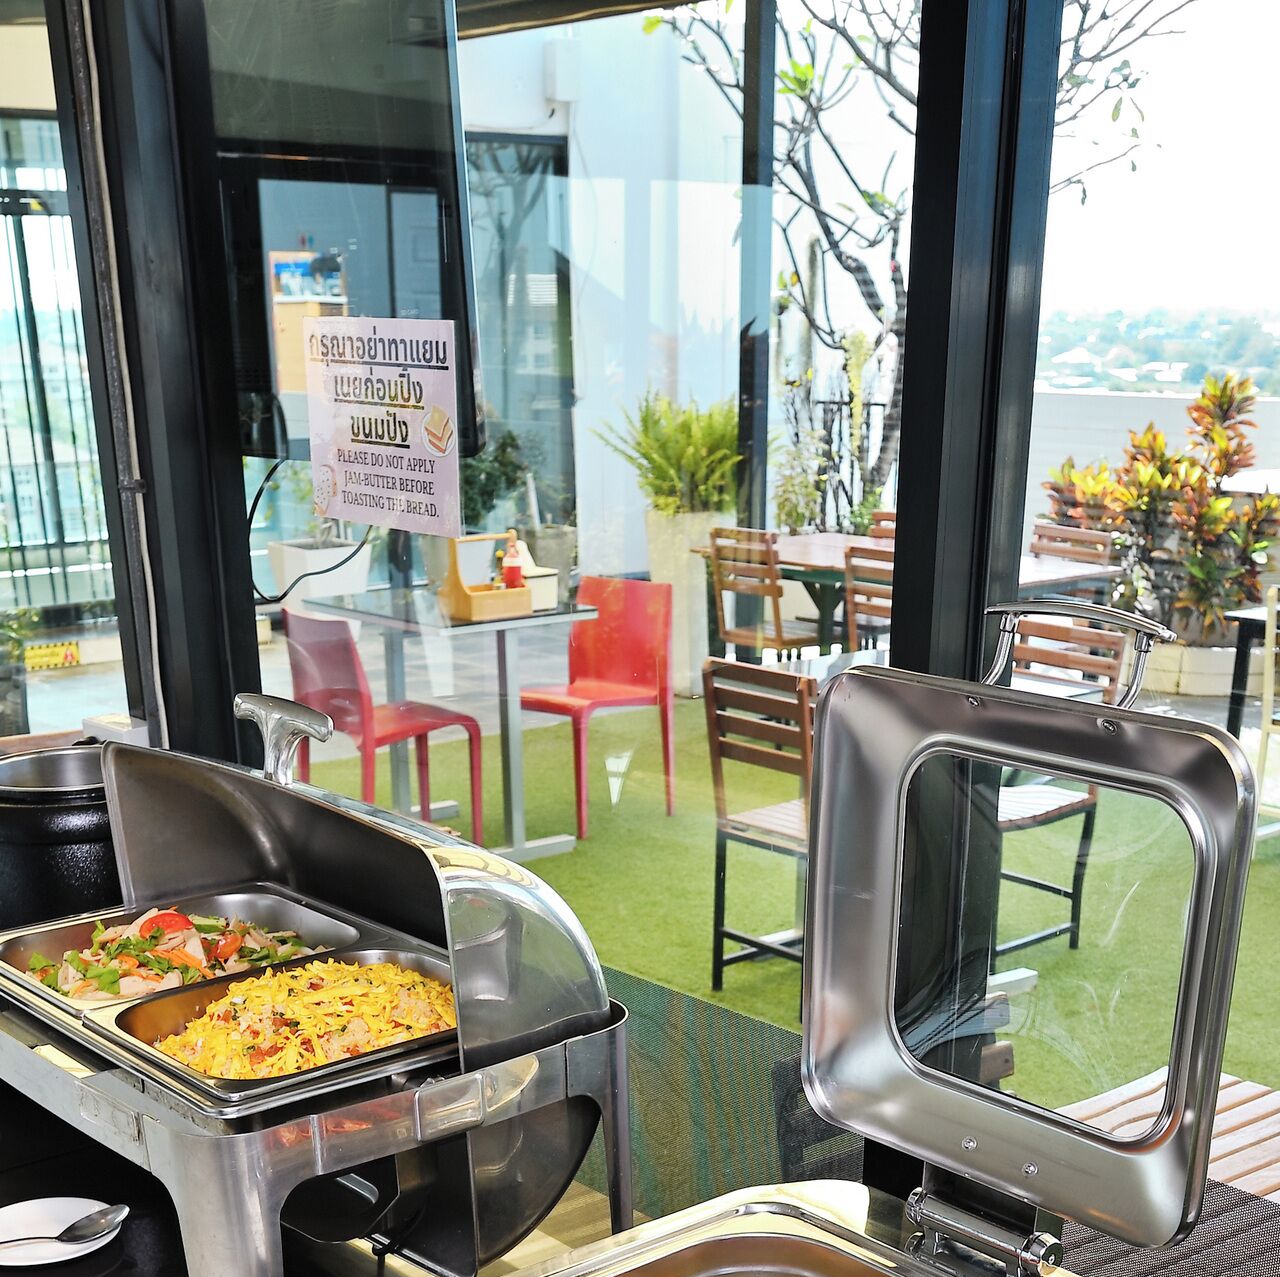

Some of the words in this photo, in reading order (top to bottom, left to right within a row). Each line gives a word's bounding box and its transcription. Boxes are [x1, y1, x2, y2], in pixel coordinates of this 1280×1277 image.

[309, 325, 447, 367] กรุณาอย่าทาแยม
[351, 410, 409, 443] ขนมปัง
[337, 448, 369, 465] PLEASE
[371, 453, 383, 468] DO
[385, 454, 404, 470] NOT
[406, 457, 435, 474] APPLY
[344, 470, 398, 490] JAM-BUTTER
[399, 477, 435, 496] BEFORE
[341, 490, 385, 509] TOASTING
[386, 497, 405, 513] THE
[406, 500, 440, 517] BREAD.
